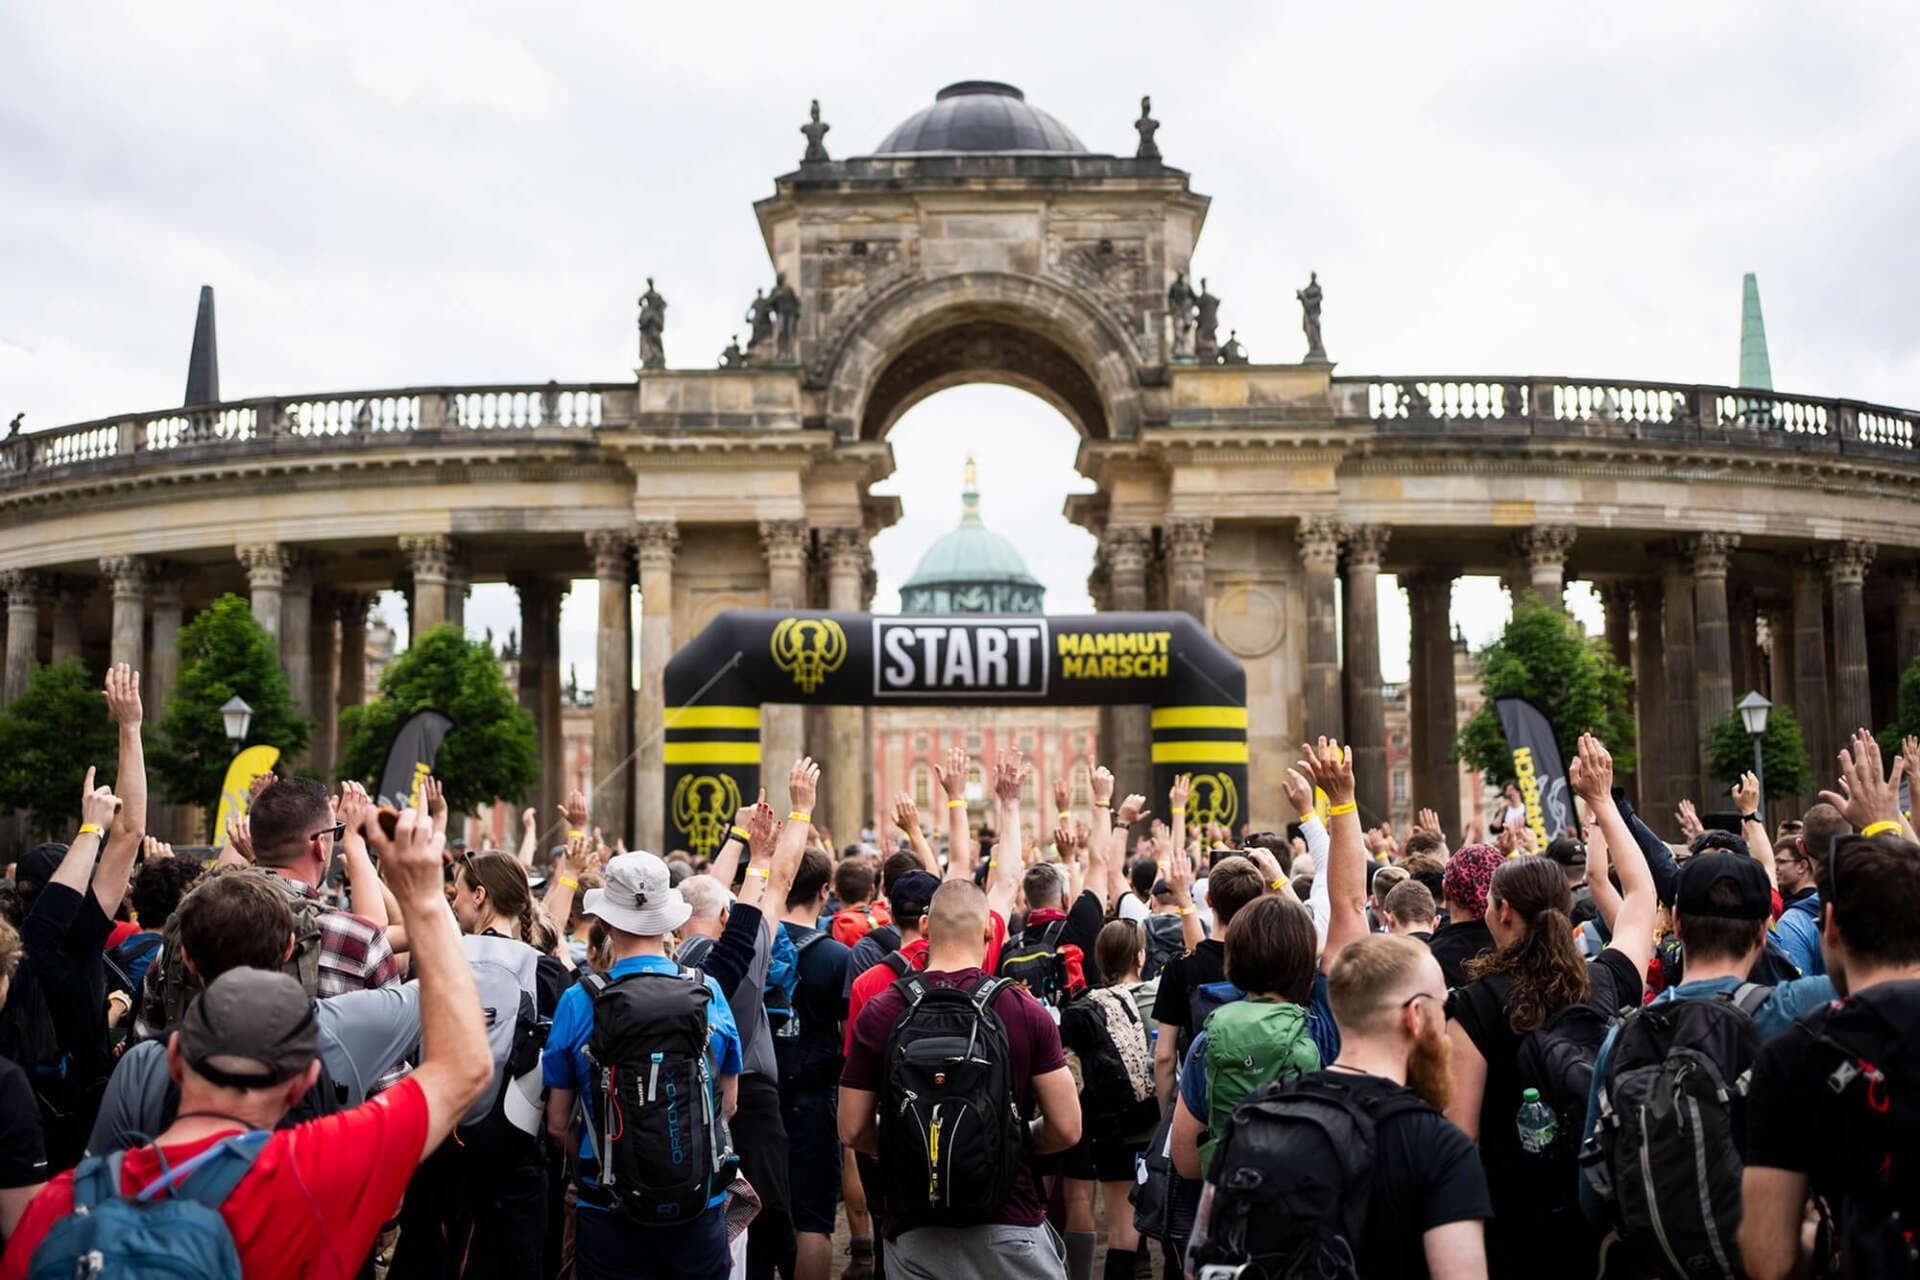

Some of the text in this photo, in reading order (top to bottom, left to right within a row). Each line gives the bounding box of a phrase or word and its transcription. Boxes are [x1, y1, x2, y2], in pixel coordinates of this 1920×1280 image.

[884, 626, 1040, 687] START
[1057, 632, 1171, 656] MAMMUT
[1062, 654, 1169, 679] MARSCH
[664, 1071, 685, 1165] ORTOVOX
